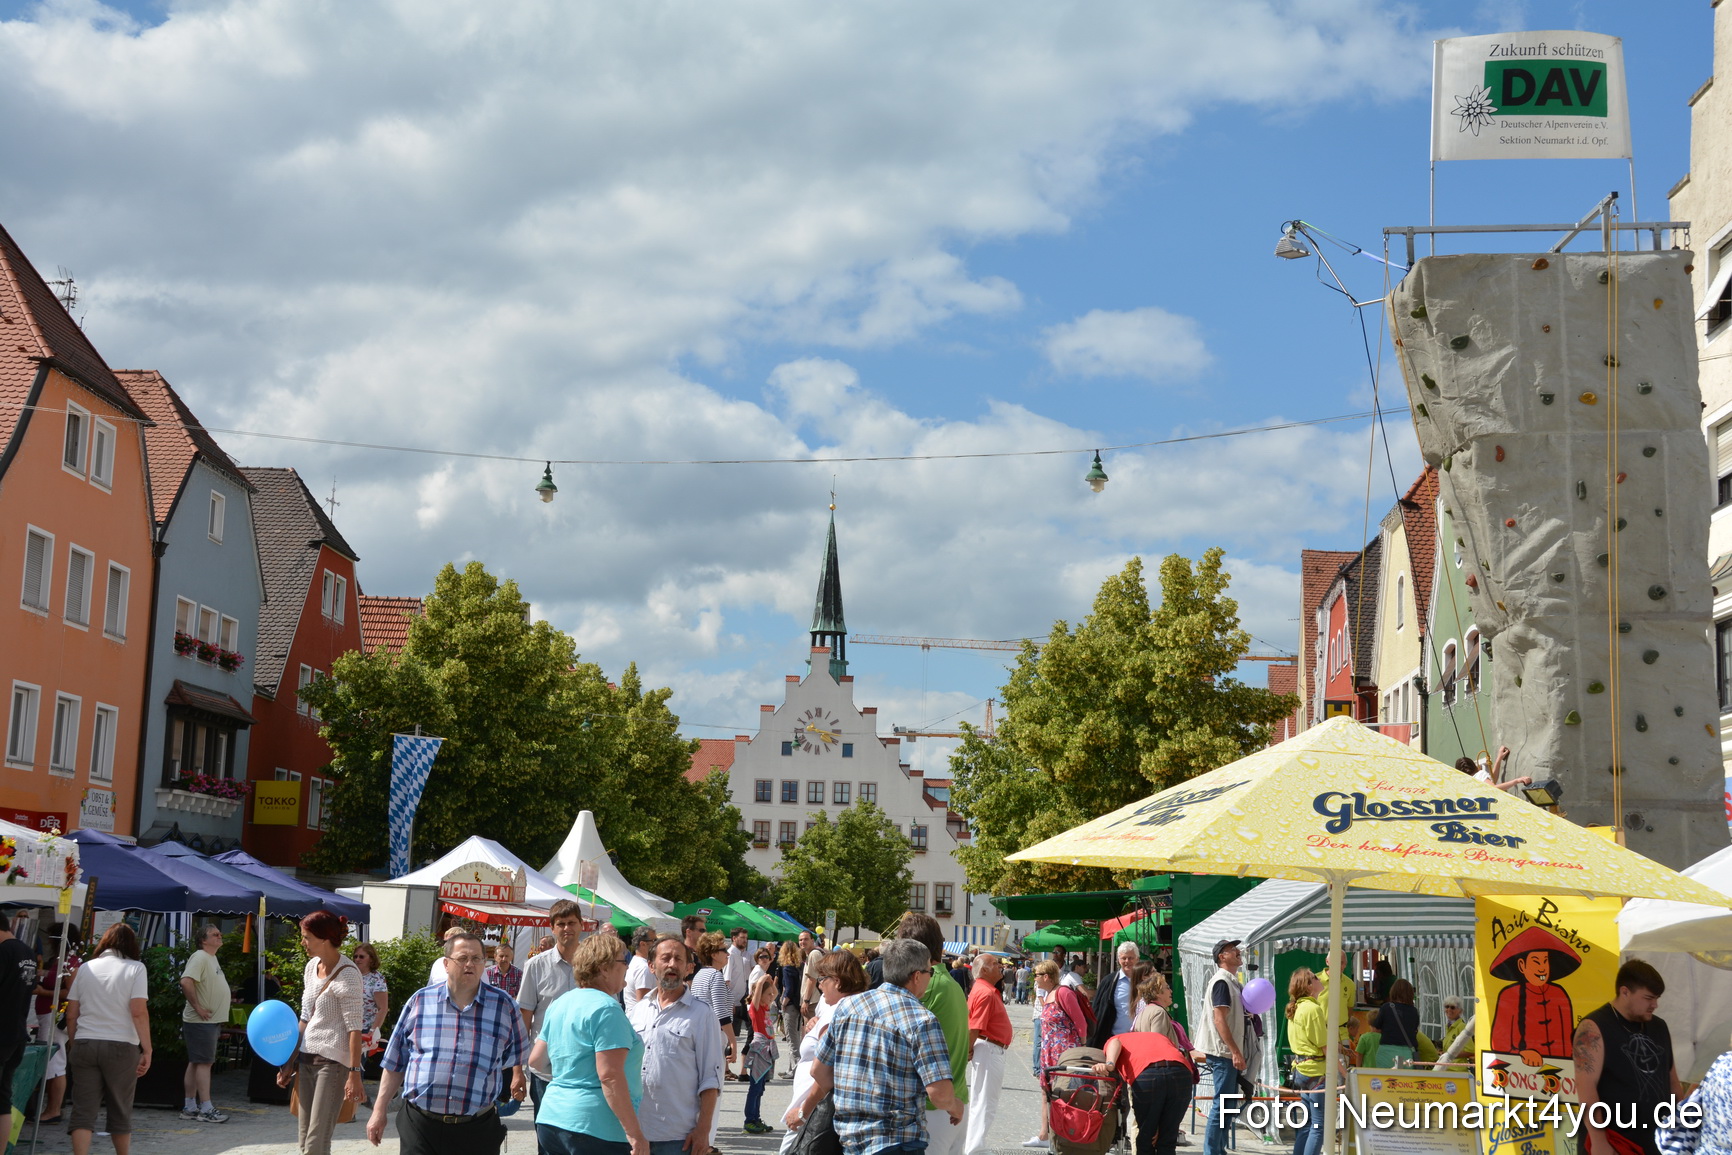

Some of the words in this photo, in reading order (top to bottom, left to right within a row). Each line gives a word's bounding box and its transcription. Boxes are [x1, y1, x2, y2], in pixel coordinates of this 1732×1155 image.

[1489, 42, 1547, 57] Zukunft
[1551, 42, 1604, 59] schützen
[1502, 68, 1602, 107] DAV
[1500, 120, 1542, 129] Deutscher
[1544, 120, 1593, 131] Alpenverein
[1594, 121, 1608, 130] e.V.
[1499, 135, 1532, 145] Sektion
[1534, 135, 1575, 145] Neumarkt
[1577, 136, 1590, 145] i.d.
[1591, 136, 1608, 147] Opf.
[1366, 779, 1395, 791] Seit
[91, 792, 104, 804] OBST
[87, 803, 109, 818] GEMÜSE
[1313, 791, 1499, 835] Glossner
[40, 818, 61, 829] DER
[1430, 821, 1527, 849] Bier
[1305, 834, 1352, 850] Der
[1358, 840, 1456, 860] hochfeine
[1463, 847, 1585, 870] Biergenuss
[440, 882, 510, 901] MANDELN
[1492, 910, 1530, 949] Asia
[1534, 896, 1591, 953] Bistro
